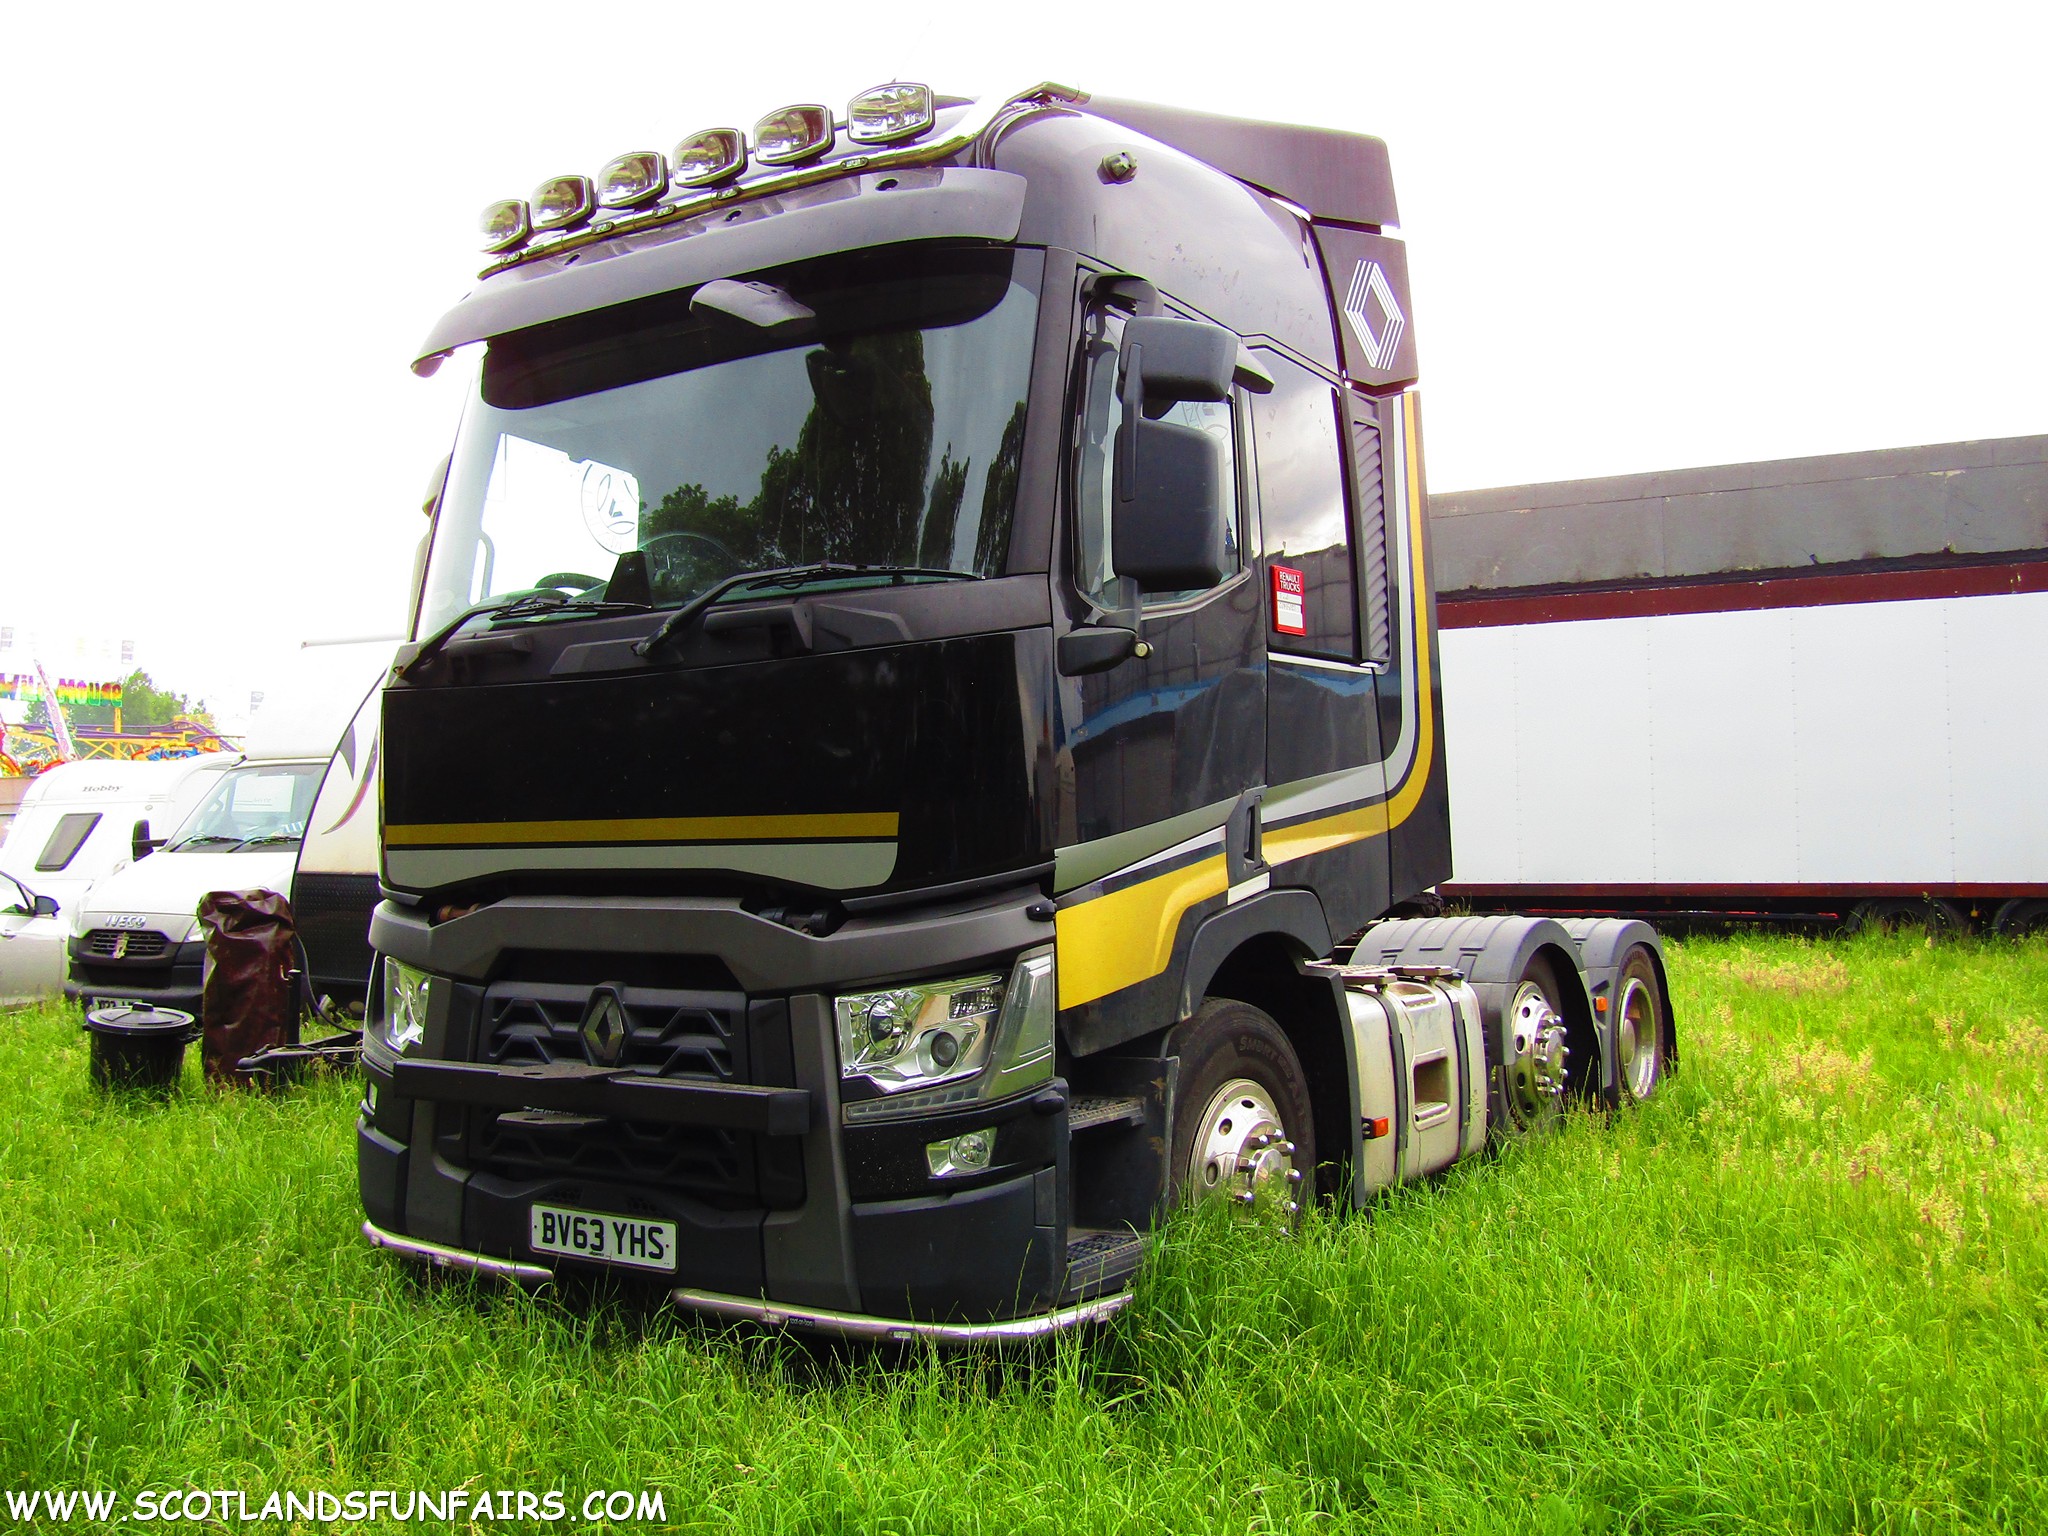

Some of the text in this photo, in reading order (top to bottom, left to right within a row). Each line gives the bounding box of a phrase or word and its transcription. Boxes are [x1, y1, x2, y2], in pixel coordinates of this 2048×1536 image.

[1279, 571, 1300, 584] RENAULT
[1280, 580, 1300, 592] TRUCKS
[82, 784, 123, 793] Hobby
[105, 913, 147, 928] IVECO
[542, 1212, 664, 1260] BV63 YHS
